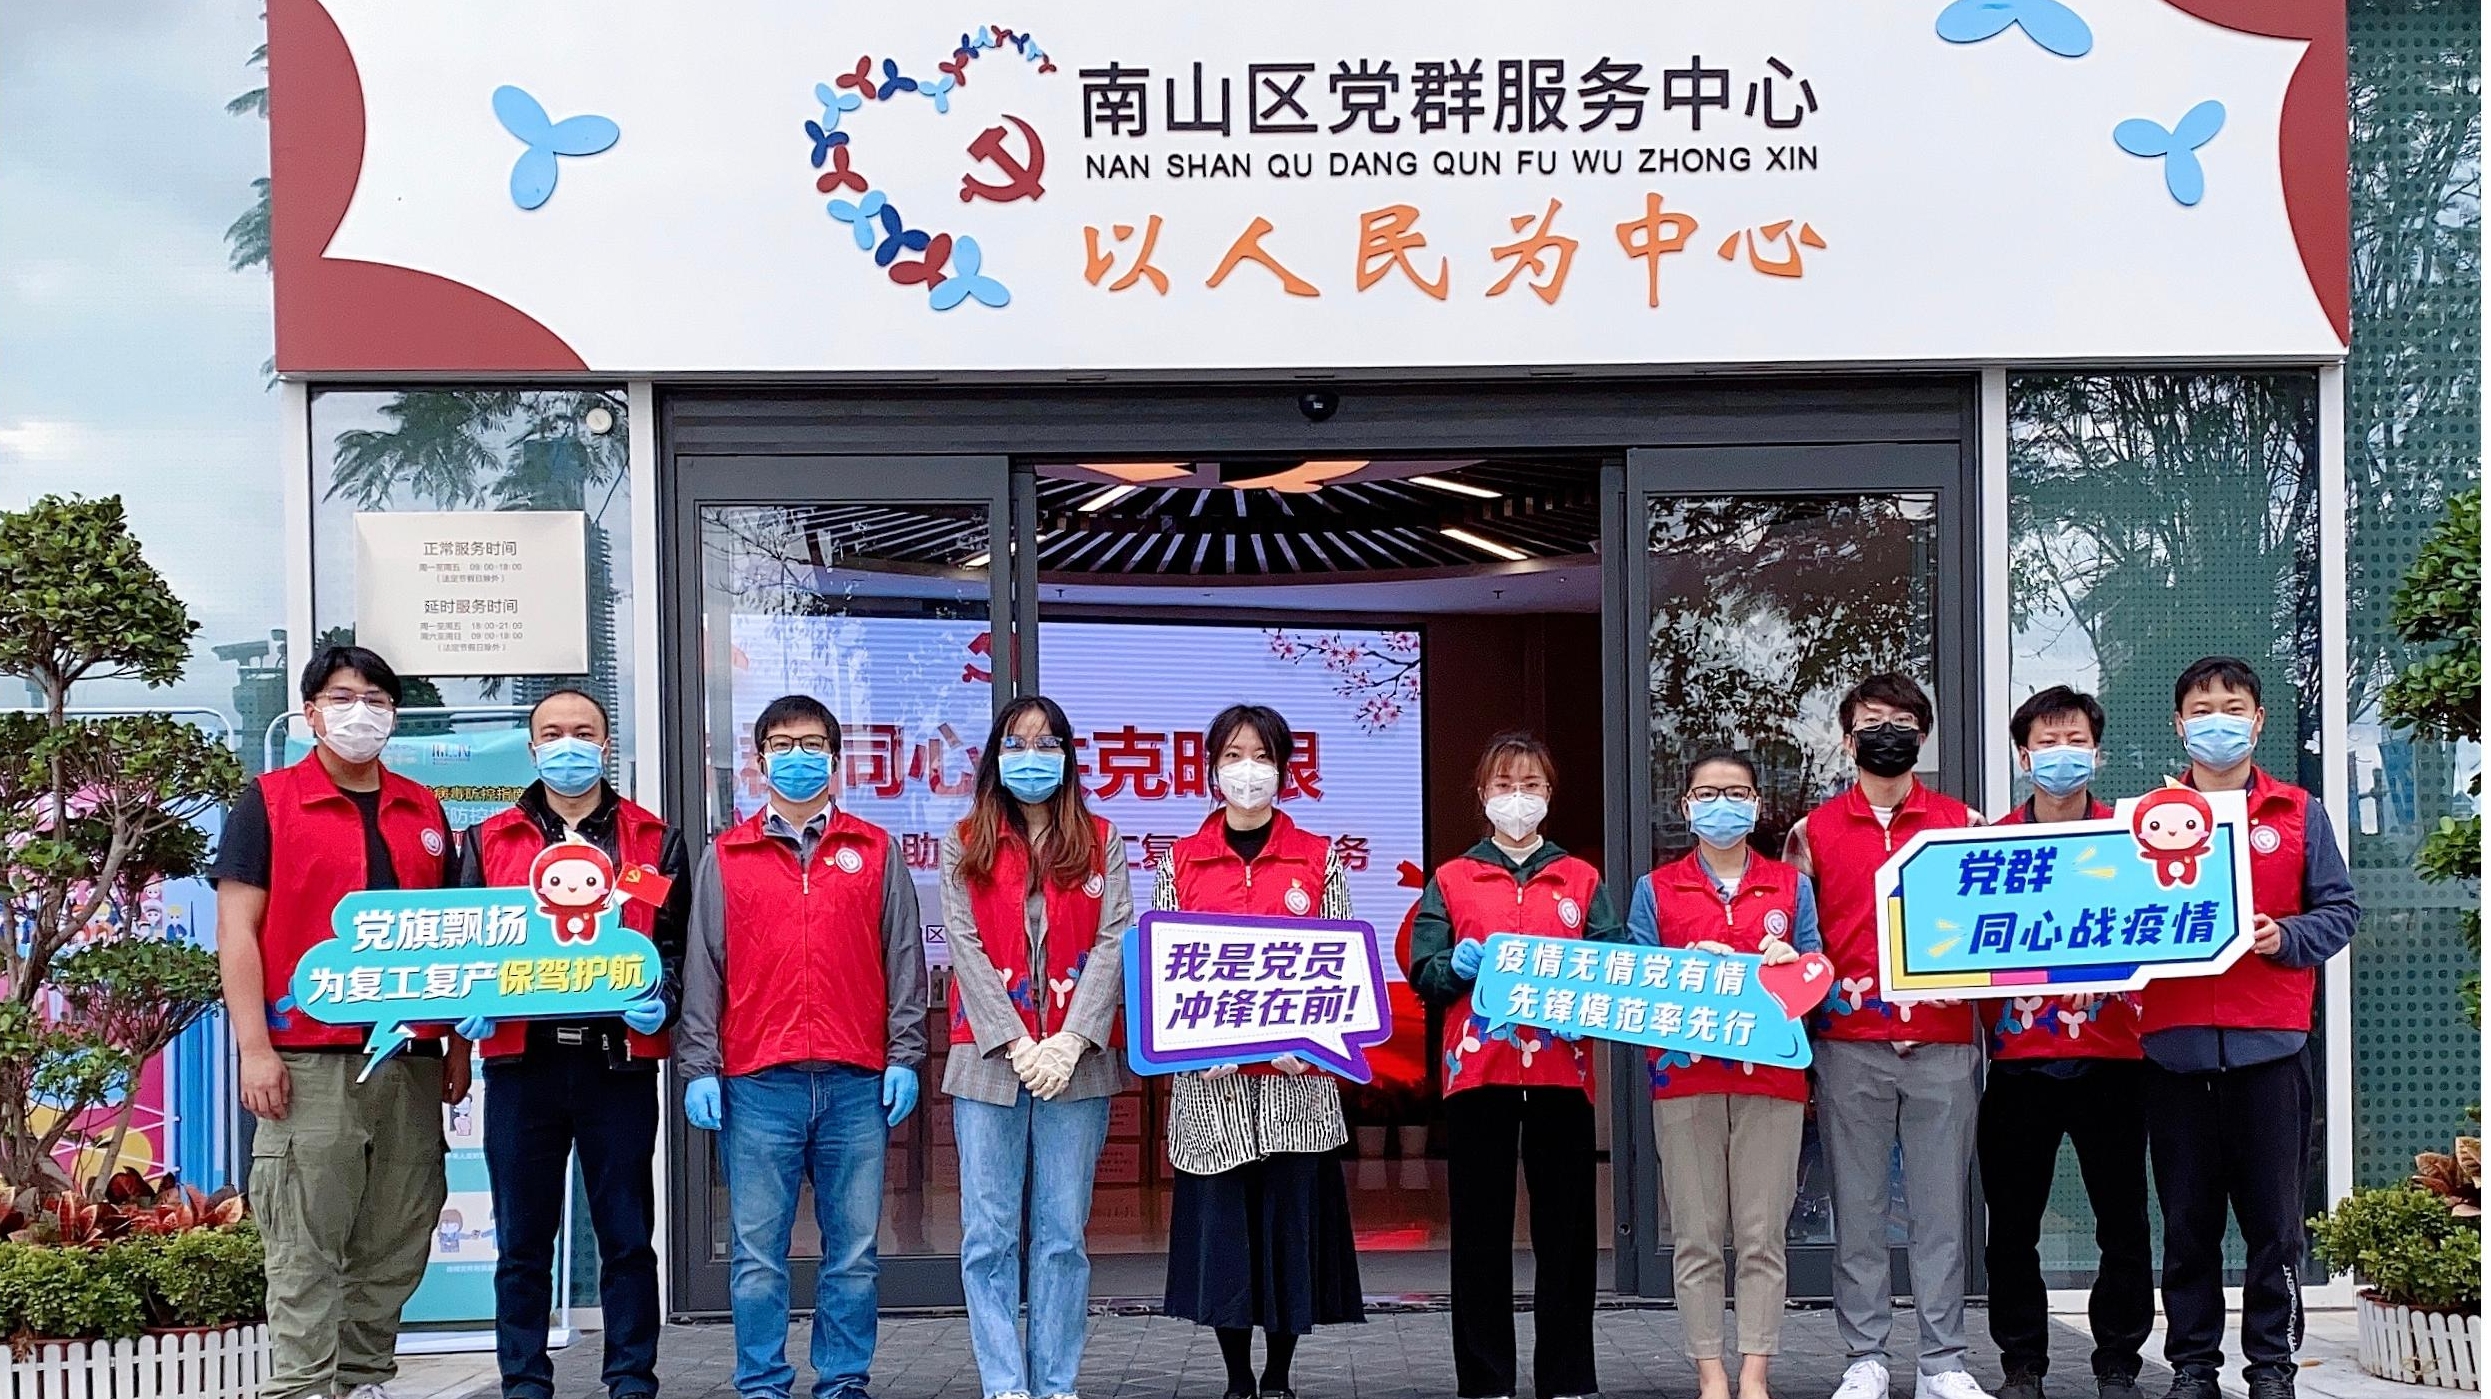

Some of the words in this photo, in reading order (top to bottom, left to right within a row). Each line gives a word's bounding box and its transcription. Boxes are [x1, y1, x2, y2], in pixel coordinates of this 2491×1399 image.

[1079, 55, 1818, 138] 南山区党群服务中心
[1086, 154, 1150, 179] NAN
[1166, 152, 1251, 179] SHAN
[1267, 153, 1312, 179] QU
[1329, 151, 1417, 177] DANG
[1433, 150, 1501, 177] QUN
[1517, 150, 1557, 175] FU
[1572, 149, 1622, 175] WU
[1638, 147, 1751, 174] ZHONG
[1765, 145, 1818, 172] XIN
[1083, 192, 1826, 307] 以人民为中心
[423, 540, 517, 557] 正常服务时间
[424, 598, 519, 615] 延时服务时间
[1957, 845, 2058, 897] 党群
[353, 905, 528, 952] 党旗飘扬
[1968, 900, 2220, 956] 同心战疫情
[308, 953, 647, 1005] 为复工复产保驾护航
[1165, 942, 1347, 982] 我是党员
[1495, 939, 1748, 997] 疫情无情党有情
[1166, 984, 1361, 1031] 冲锋在前!
[1505, 983, 1757, 1047] 先锋模范率先行
